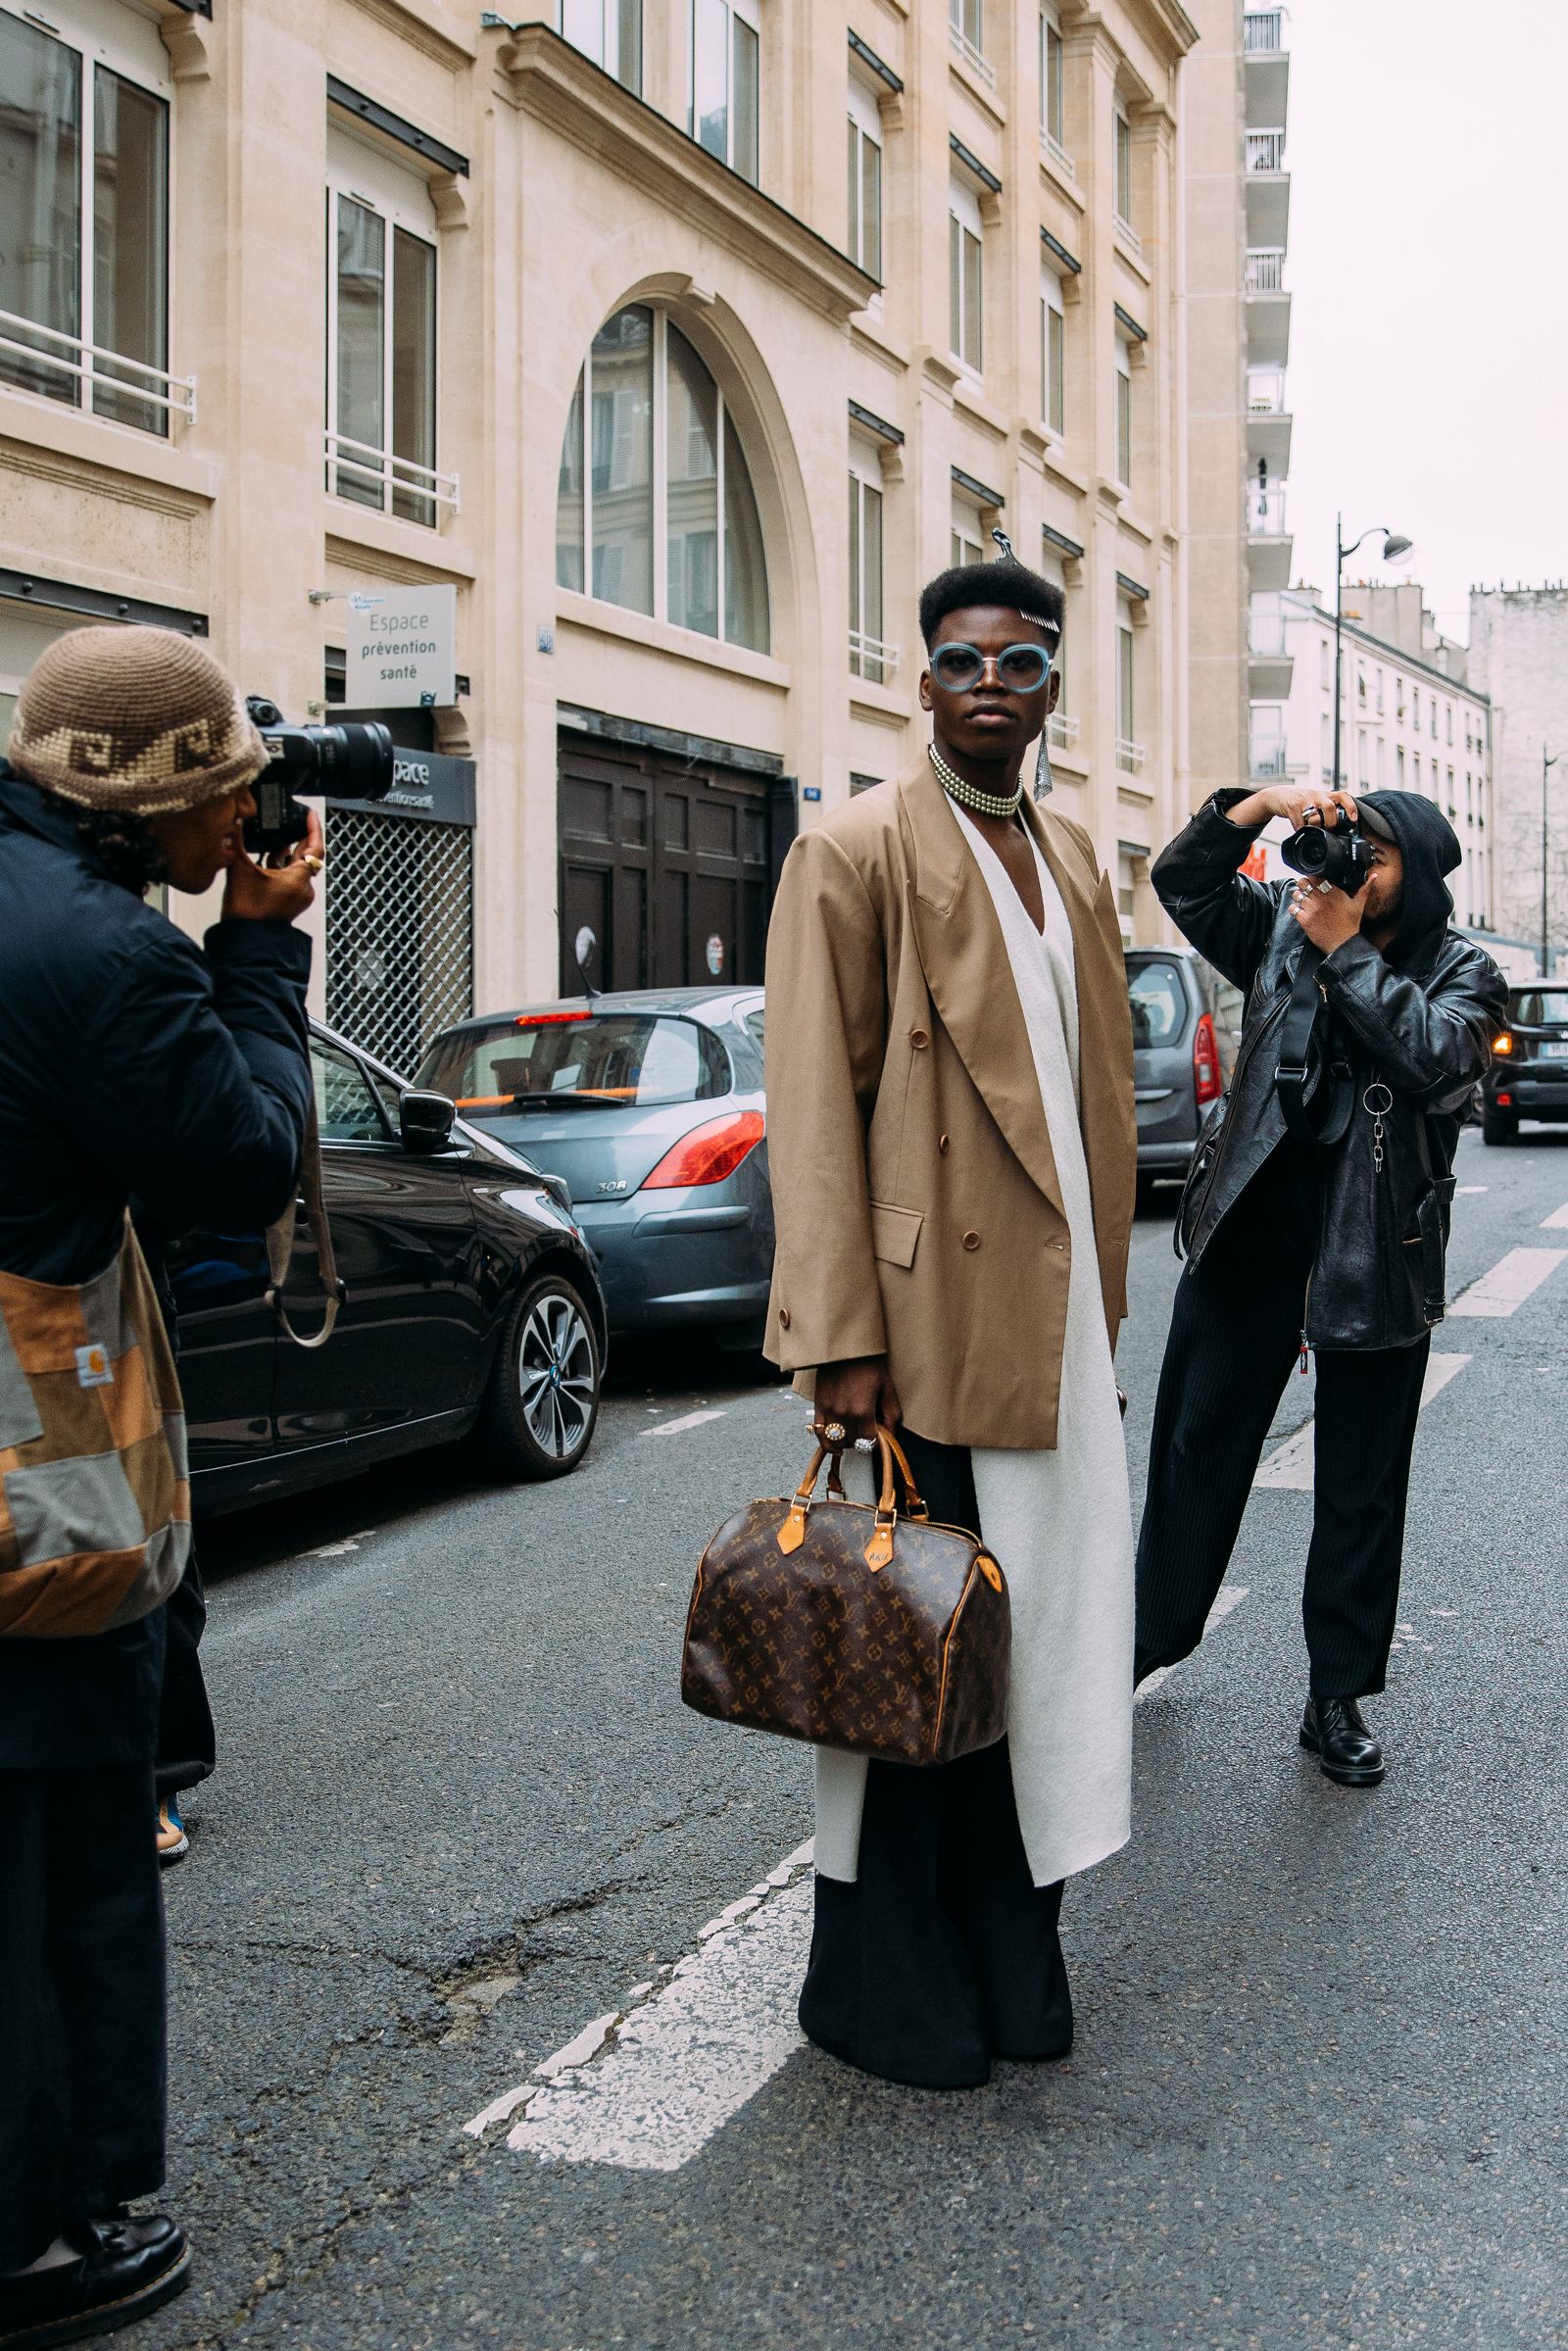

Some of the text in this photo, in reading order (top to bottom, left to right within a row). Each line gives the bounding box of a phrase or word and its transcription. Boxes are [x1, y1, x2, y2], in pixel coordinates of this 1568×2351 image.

[369, 612, 429, 635] Espace
[362, 639, 436, 659] prévention
[379, 663, 417, 680] santé
[596, 1180, 627, 1193] 308
